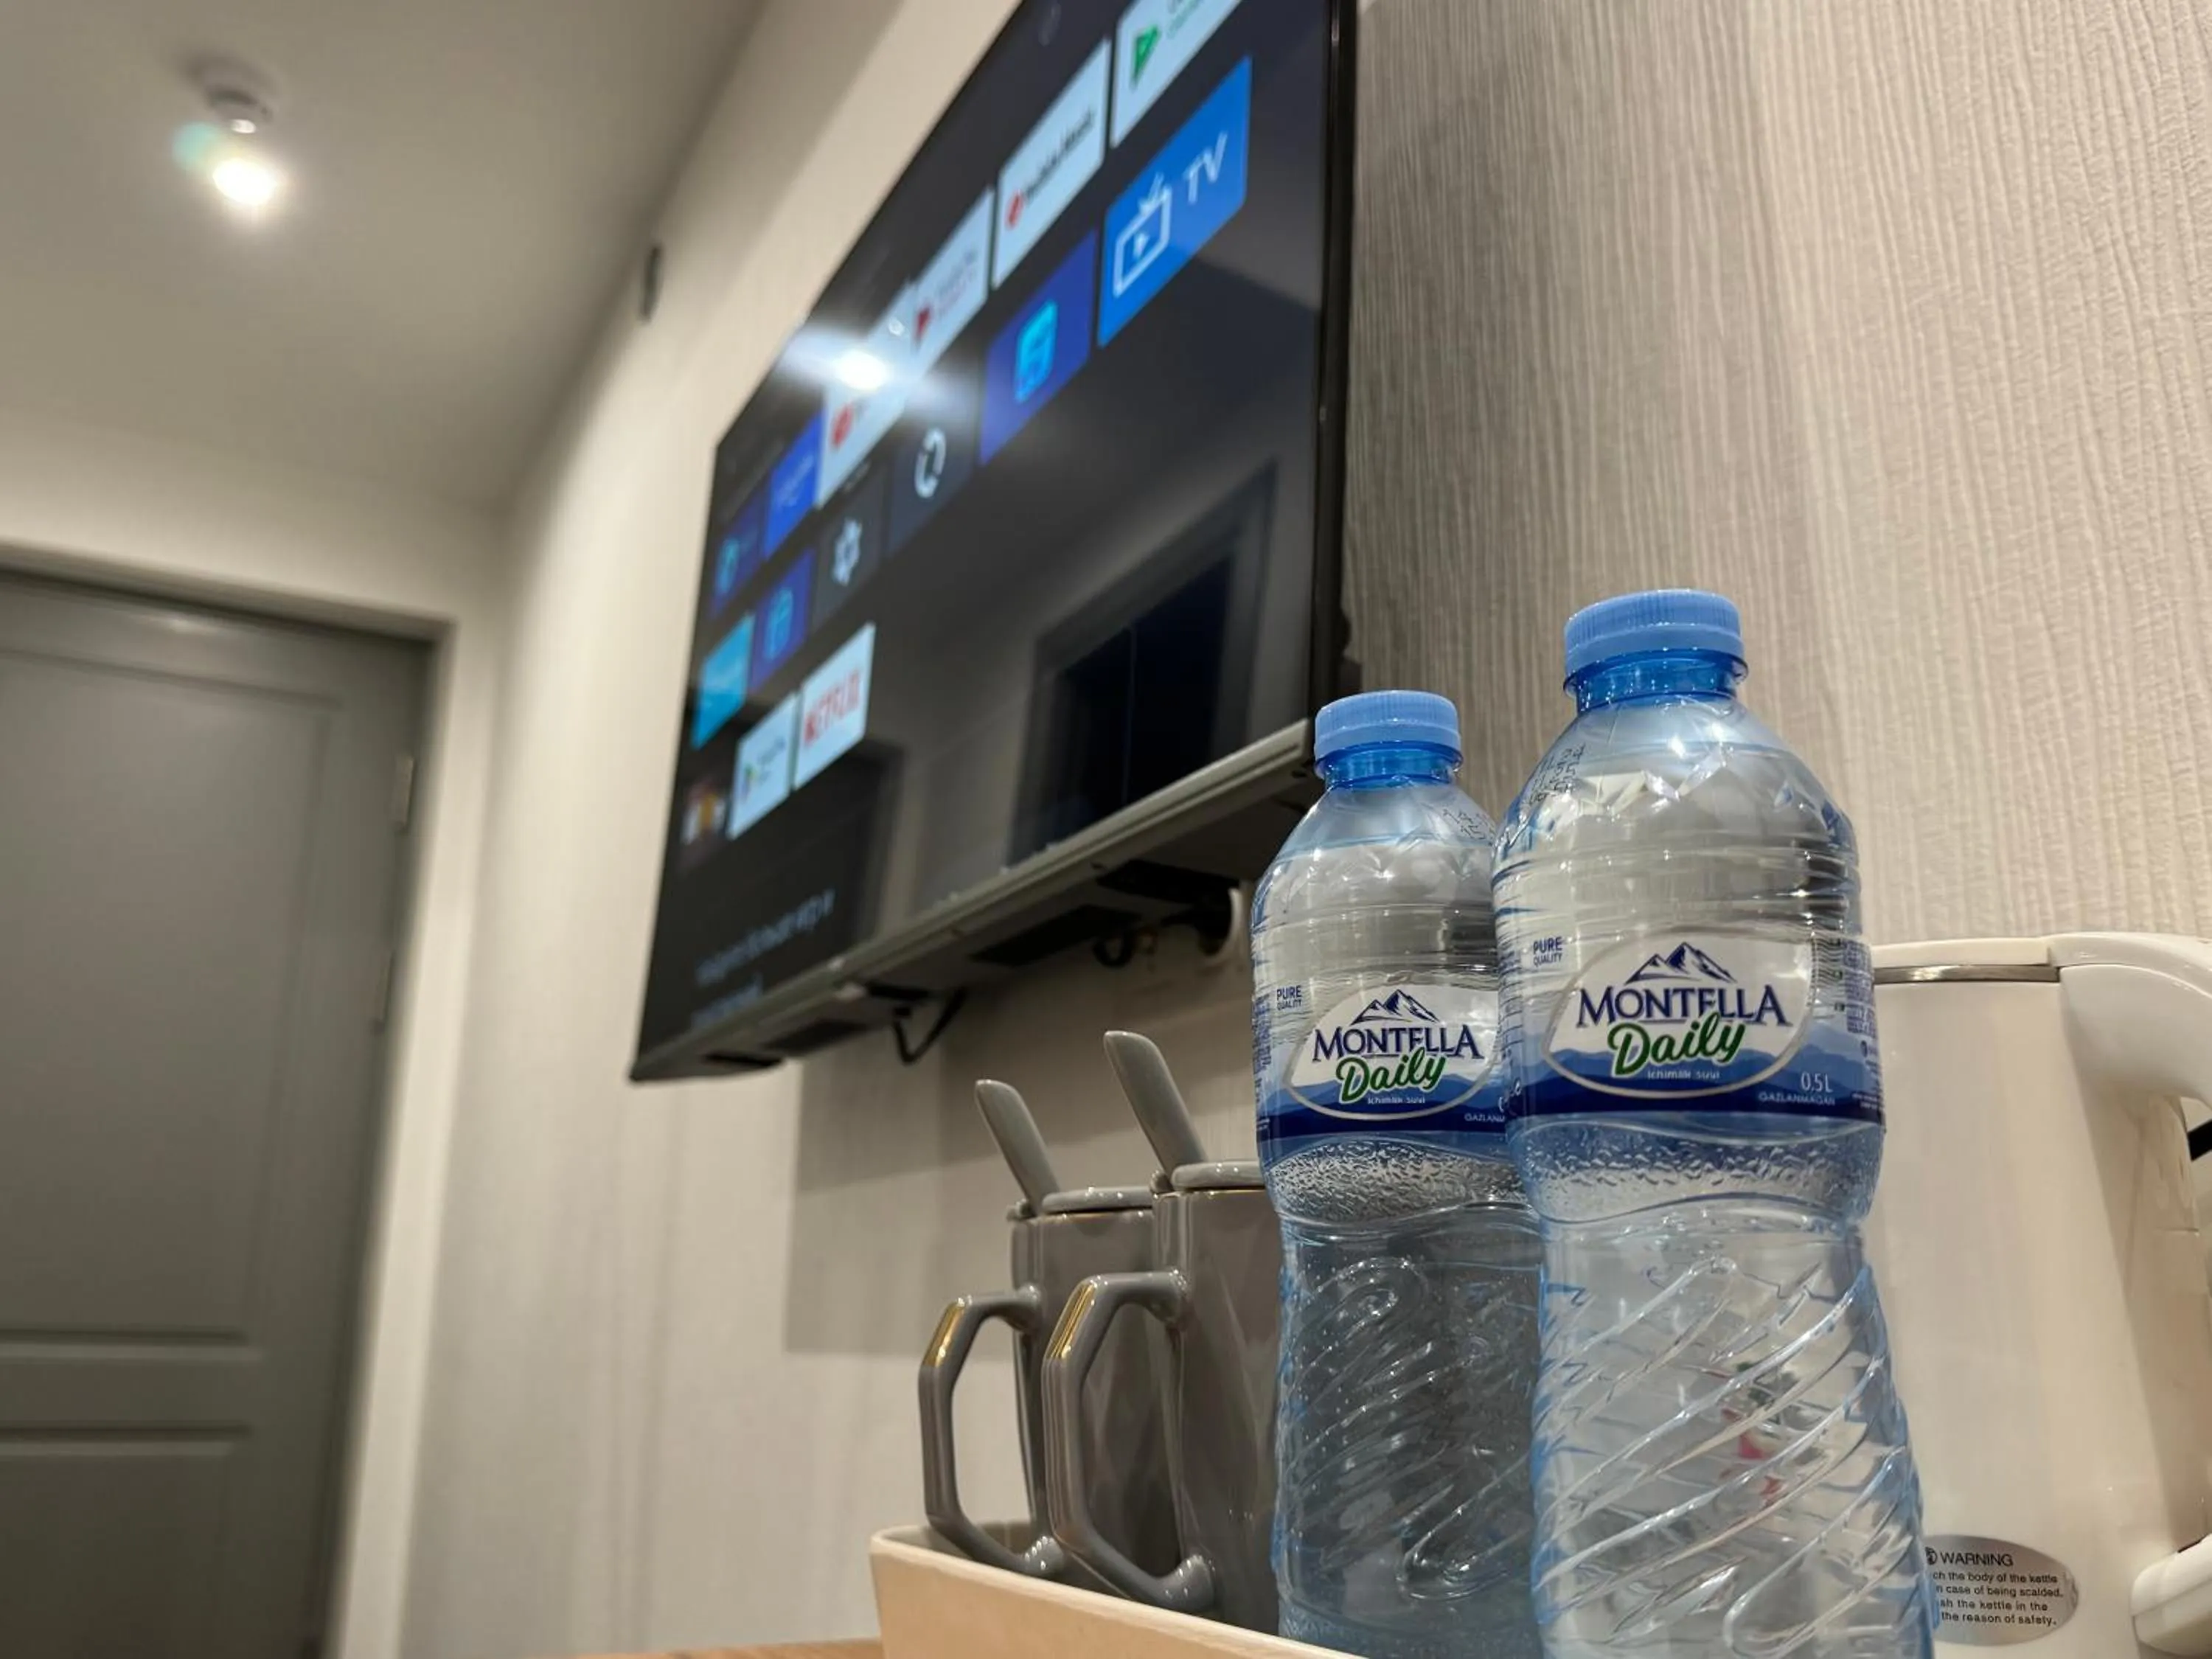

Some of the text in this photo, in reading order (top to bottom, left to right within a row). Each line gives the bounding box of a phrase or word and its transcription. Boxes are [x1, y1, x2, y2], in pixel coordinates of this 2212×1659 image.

[1181, 131, 1228, 204] TV
[1534, 936, 1562, 954] PURE
[1276, 985, 1302, 1001] PURE
[1576, 984, 1792, 1027] MONTELLA
[1312, 1024, 1485, 1062] MONTELLA
[1607, 1012, 1745, 1076] Daily
[1336, 1047, 1447, 1103] Daily
[1940, 1551, 2014, 1567] WARNING
[1948, 1571, 1965, 1581] the
[1967, 1572, 1993, 1584] body
[1997, 1573, 2006, 1582] of
[2009, 1573, 2026, 1583] the
[2029, 1574, 2057, 1584] kettle
[1946, 1586, 1971, 1594] case
[1974, 1585, 1984, 1595] of
[1987, 1586, 2017, 1598] being
[2020, 1587, 2064, 1598] scalded.
[1958, 1599, 1975, 1609] the
[1980, 1600, 2012, 1610] kettle
[2016, 1601, 2026, 1611] in
[2030, 1601, 2048, 1611] the
[1941, 1612, 2057, 1627] the reason of safety.
